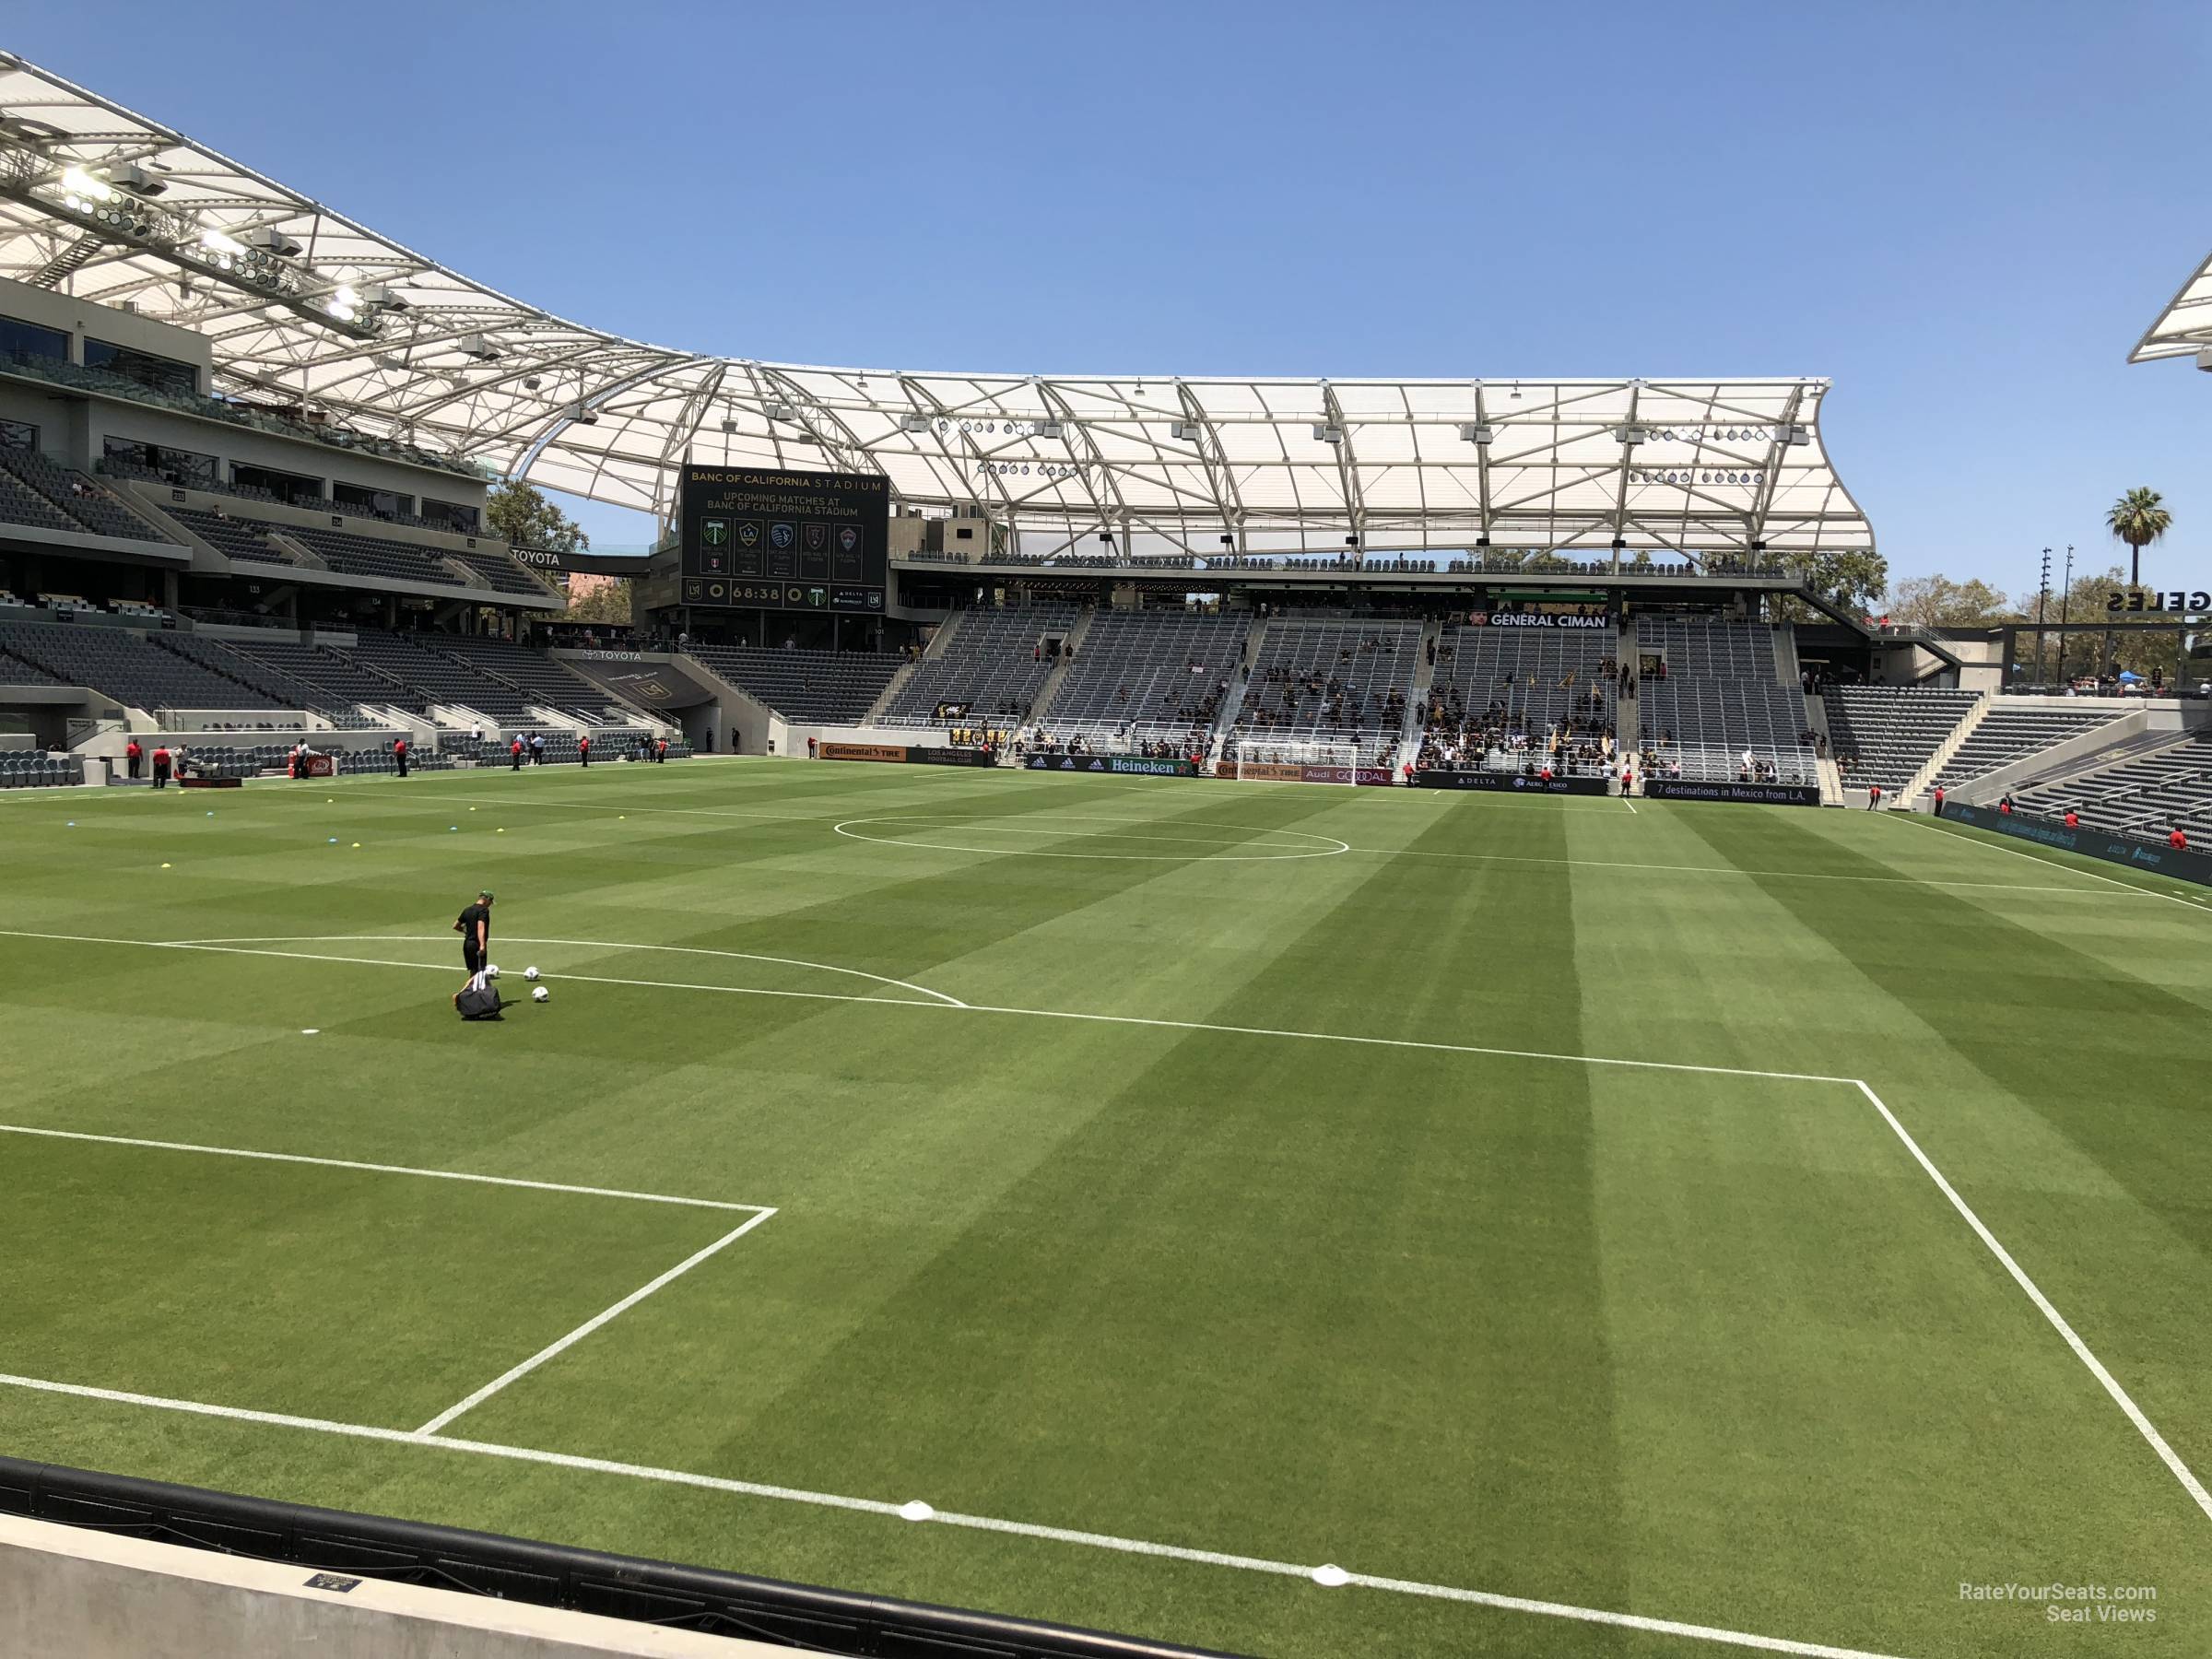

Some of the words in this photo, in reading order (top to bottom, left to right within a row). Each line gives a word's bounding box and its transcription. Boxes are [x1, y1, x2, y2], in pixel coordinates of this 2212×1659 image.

[691, 472, 724, 482] BANC
[725, 475, 742, 483] OF
[744, 476, 811, 487] CALIFORNIA
[814, 478, 881, 491] STADIUM
[724, 491, 776, 503] UPCOMING
[778, 495, 826, 506] MATCHES
[827, 498, 841, 507] AT
[707, 500, 735, 510] BANC
[736, 501, 751, 511] OF
[752, 503, 812, 515] CALIFORNIA
[814, 506, 859, 516] STADIUM
[511, 549, 560, 566] TOYOTA
[733, 587, 780, 600] 68:38
[1557, 616, 1606, 628] CIMAN
[600, 651, 642, 661] TOYOTA
[825, 745, 872, 757] Continental
[880, 749, 900, 758] TIRE
[1112, 759, 1175, 774] Heineken
[1305, 770, 1330, 778] Audi
[1466, 777, 1497, 785] DELTA
[1658, 784, 1663, 794] 7
[1665, 784, 1719, 796] destinations
[1721, 787, 1729, 796] in
[1732, 789, 1763, 798] Mexico
[1766, 789, 1786, 799] from
[1789, 792, 1806, 800] L.A.
